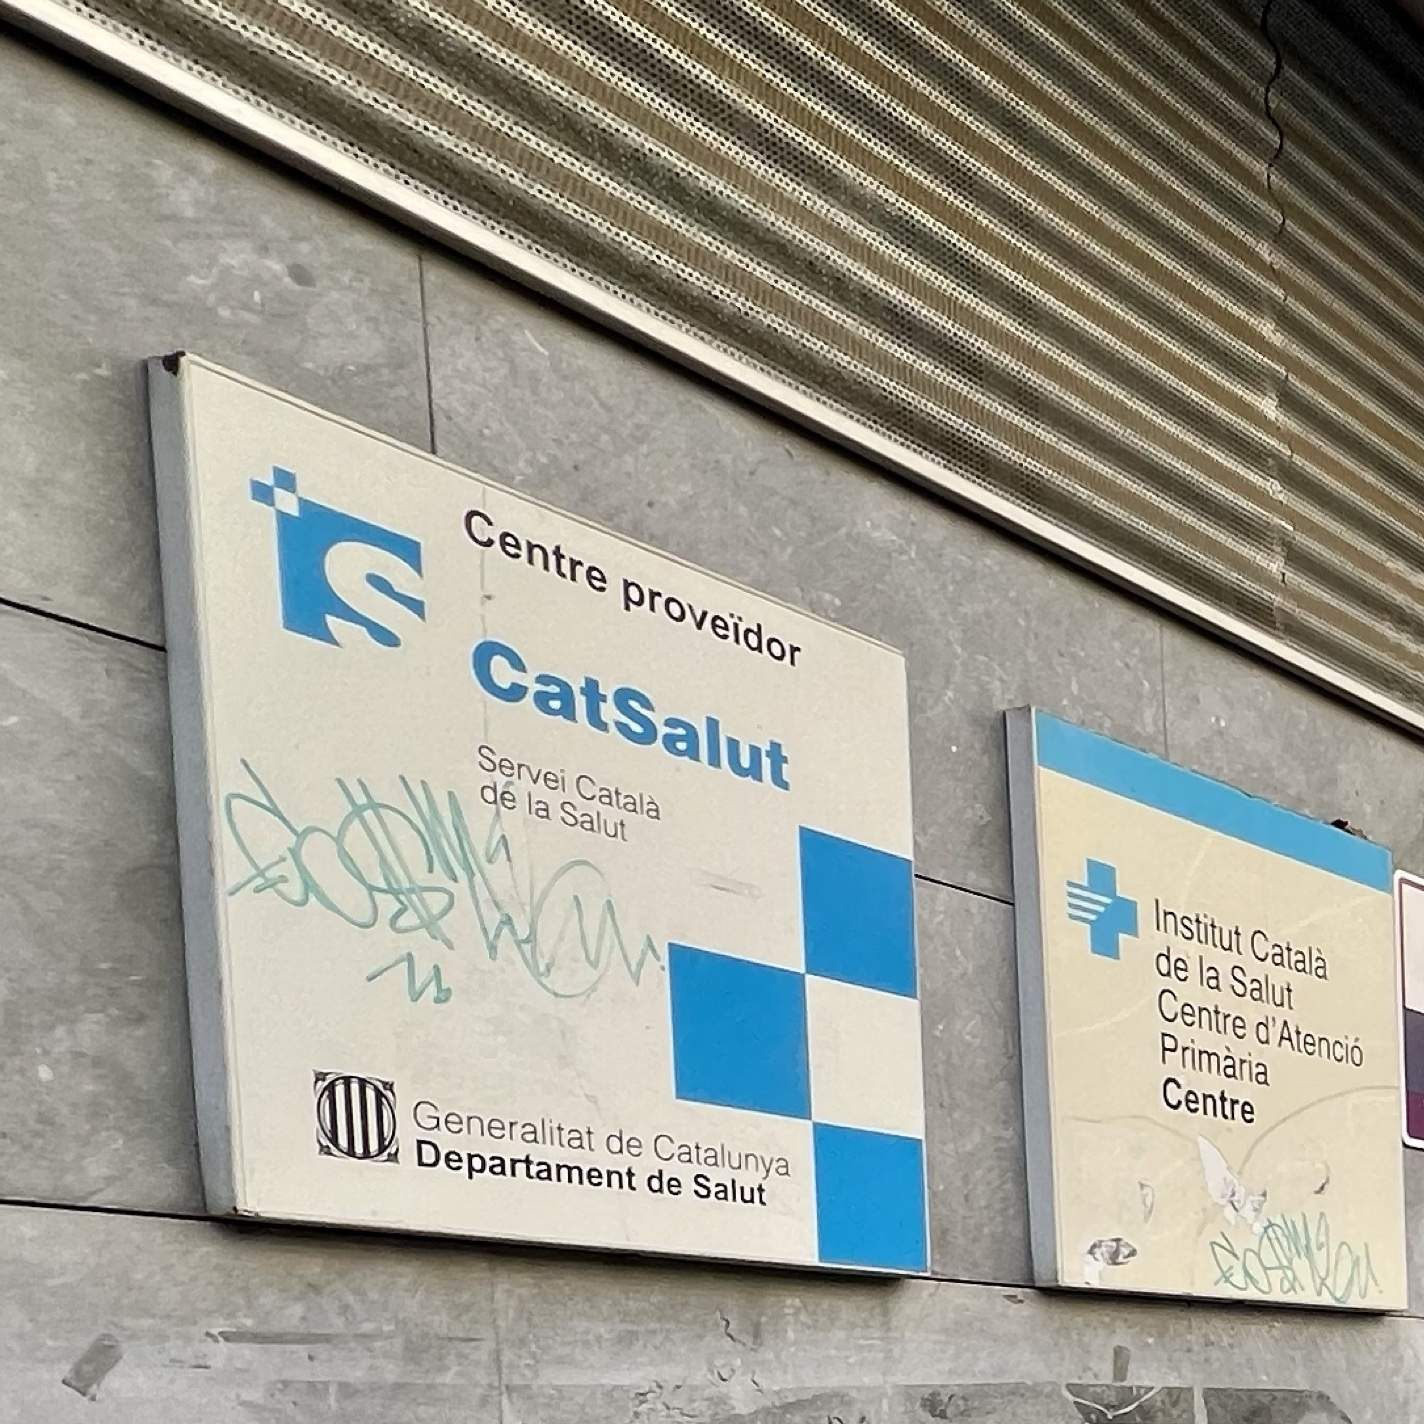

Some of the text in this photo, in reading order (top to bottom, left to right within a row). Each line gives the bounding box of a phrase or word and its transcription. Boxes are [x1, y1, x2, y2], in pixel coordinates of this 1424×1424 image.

[464, 509, 802, 668] Centre proveïdor
[471, 639, 792, 792] CatSalut
[477, 744, 661, 822] Servei Català
[480, 781, 628, 843] de la Salut
[1154, 898, 1329, 982] Institut Català
[1154, 947, 1294, 1011] de la Salut
[1157, 988, 1364, 1069] Centre d'Atenció
[1160, 1033, 1270, 1087] Primària
[1162, 1076, 1256, 1124] Centre
[412, 1100, 793, 1179] Generalitat de Catalunya
[415, 1139, 768, 1208] Departament de Salut
